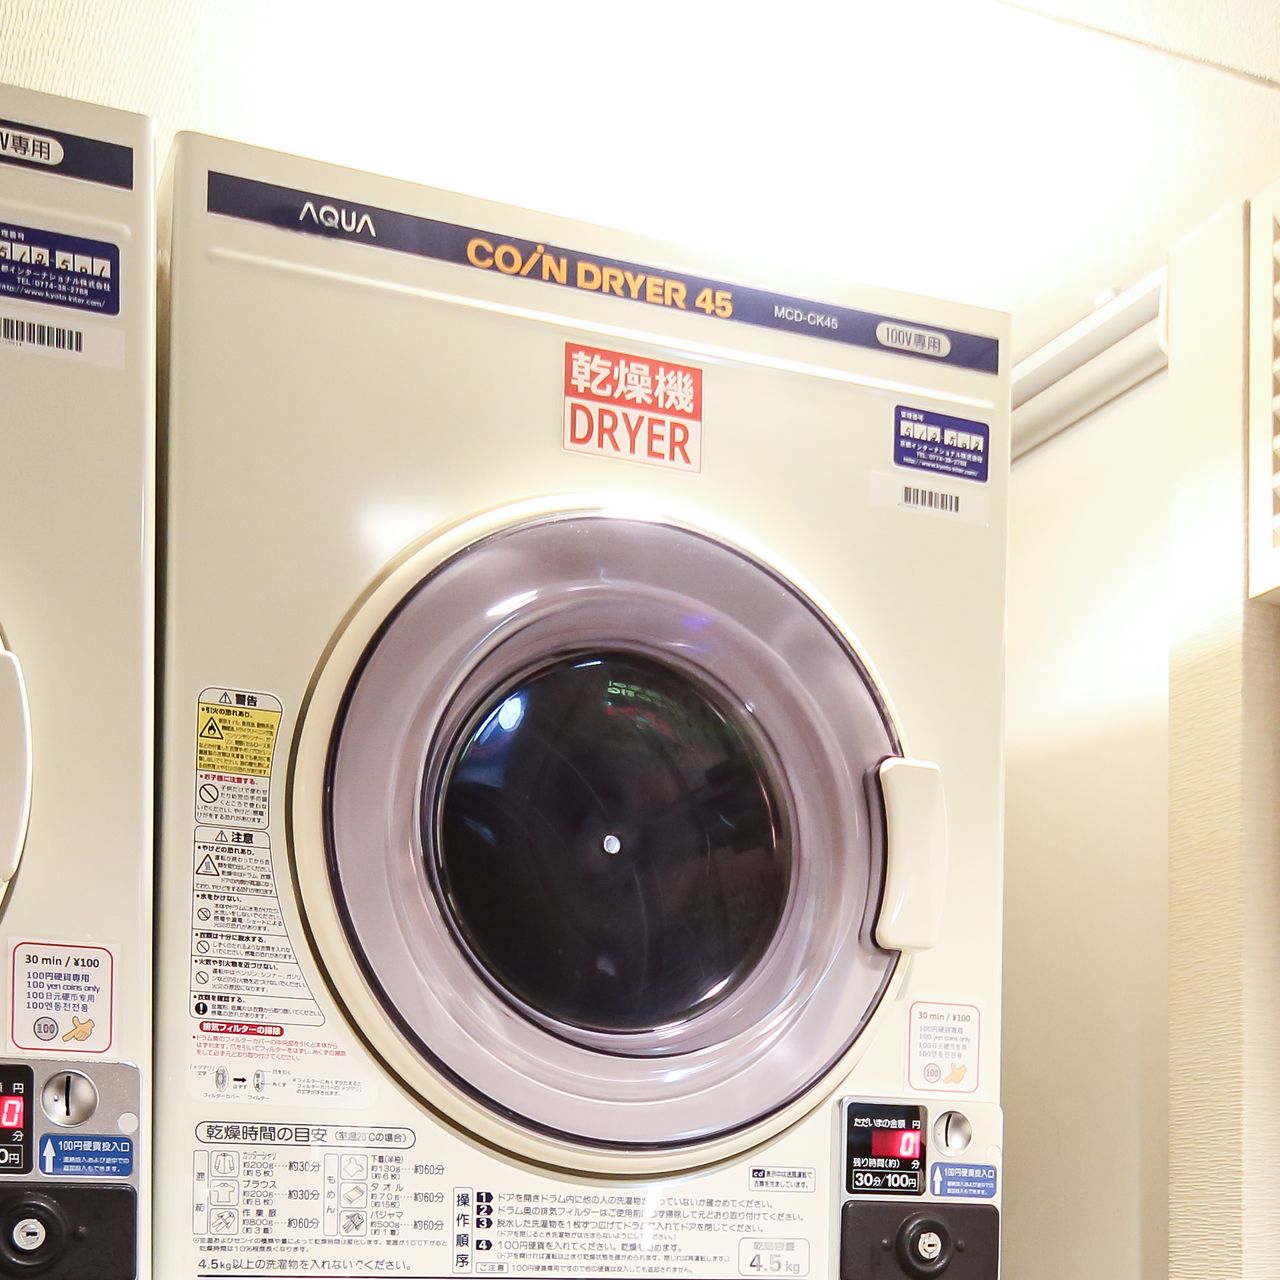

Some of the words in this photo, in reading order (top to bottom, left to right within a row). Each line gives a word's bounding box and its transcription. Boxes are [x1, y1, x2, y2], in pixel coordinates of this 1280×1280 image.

[299, 201, 377, 238] AQUA
[576, 262, 687, 311] DRYER
[695, 288, 733, 319] 45
[773, 305, 839, 330] MCD-CK45
[885, 327, 942, 353] 100V専用
[571, 351, 695, 414] 乾燥機
[569, 402, 692, 466] DRYER
[25, 954, 39, 964] 30
[41, 955, 62, 966] min
[73, 957, 100, 968] ¥100
[27, 981, 44, 989] 100
[62, 983, 82, 991] coins
[83, 984, 100, 993] only
[37, 1023, 56, 1034] 100
[13, 1082, 24, 1095] 円
[0, 1098, 23, 1128] 0
[12, 1130, 24, 1142] 分
[206, 1124, 328, 1143] 乾燥時間の目安
[413, 1164, 445, 1175] 約60分
[242, 1180, 277, 1189] ブラウス
[854, 1173, 917, 1188] 30分/100円
[288, 1190, 320, 1200] 約30分
[413, 1192, 445, 1203] 約60分
[287, 1218, 320, 1229] 約60分
[413, 1220, 444, 1231] 約60分
[455, 1193, 470, 1268] 操作順序
[749, 1253, 782, 1272] 4.5
[785, 1260, 800, 1274] kg
